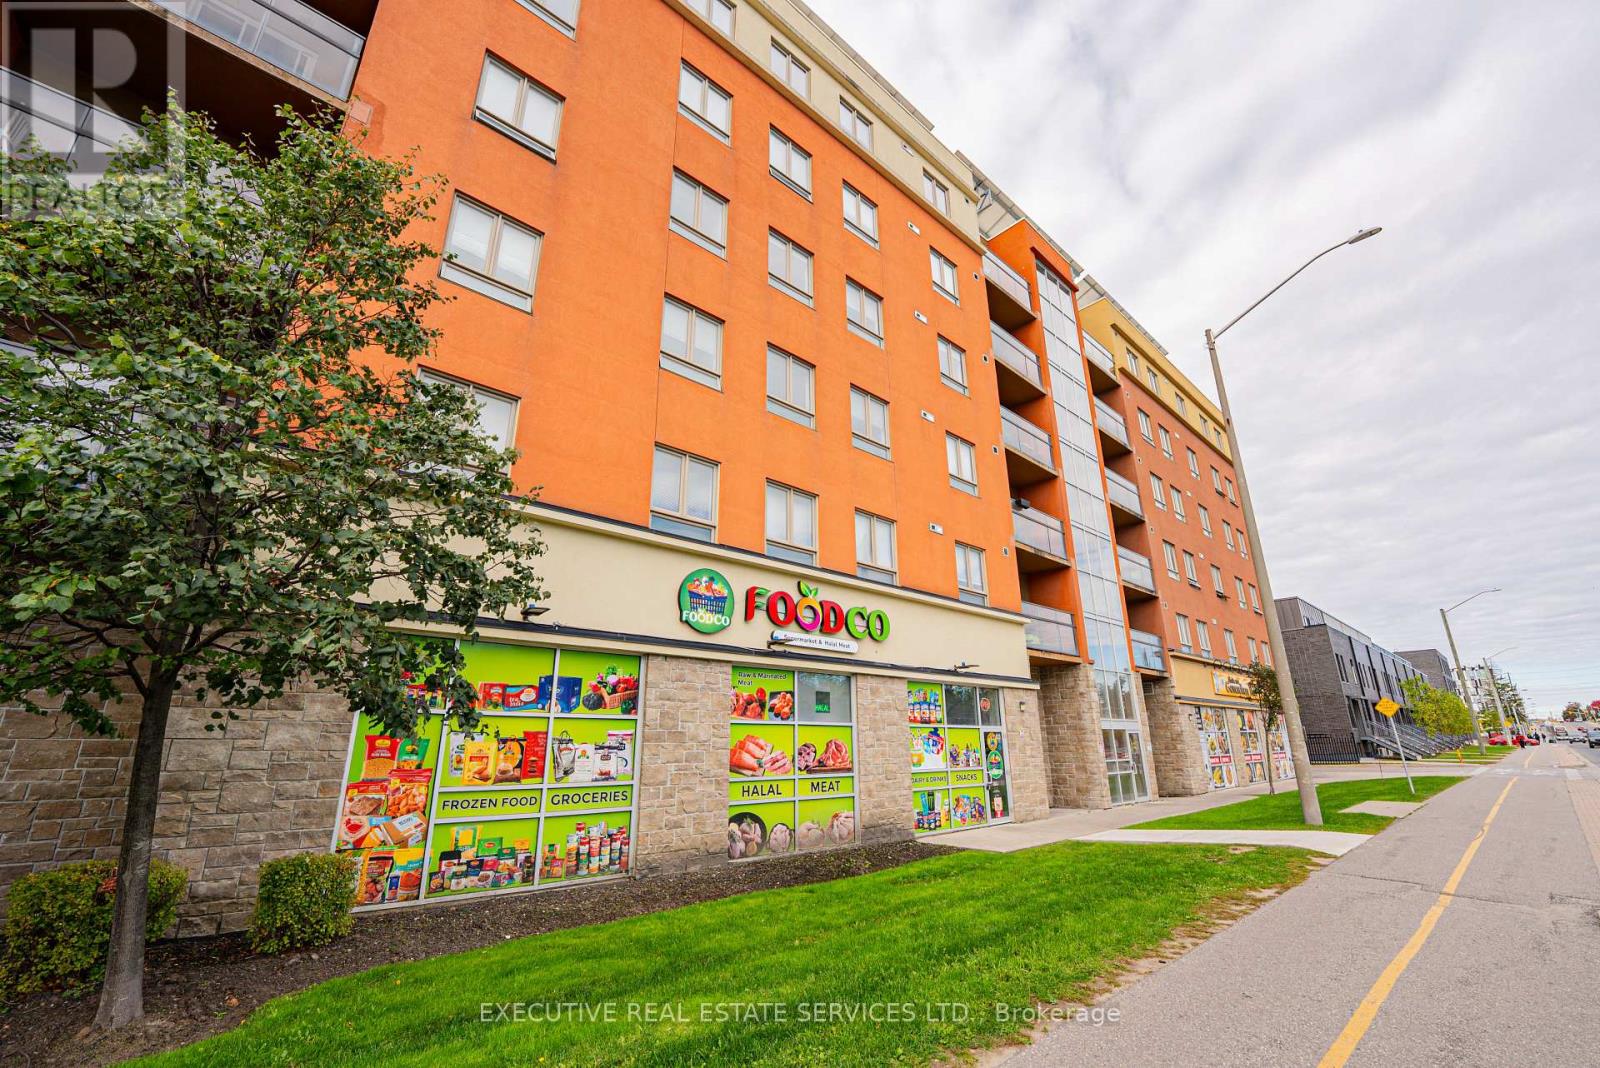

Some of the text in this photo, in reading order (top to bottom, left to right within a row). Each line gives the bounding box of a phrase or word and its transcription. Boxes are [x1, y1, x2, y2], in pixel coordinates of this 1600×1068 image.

[682, 609, 731, 626] FOODCO
[745, 584, 891, 642] FOODCO
[784, 634, 817, 645] Supermarket
[824, 640, 838, 648] Halal
[738, 671, 751, 679] Raw
[955, 773, 978, 782] SNACKS
[741, 783, 782, 798] HALAL
[810, 780, 841, 793] MEAT
[442, 796, 538, 811] FROZEN FOOD
[551, 791, 629, 806] GROCERIES
